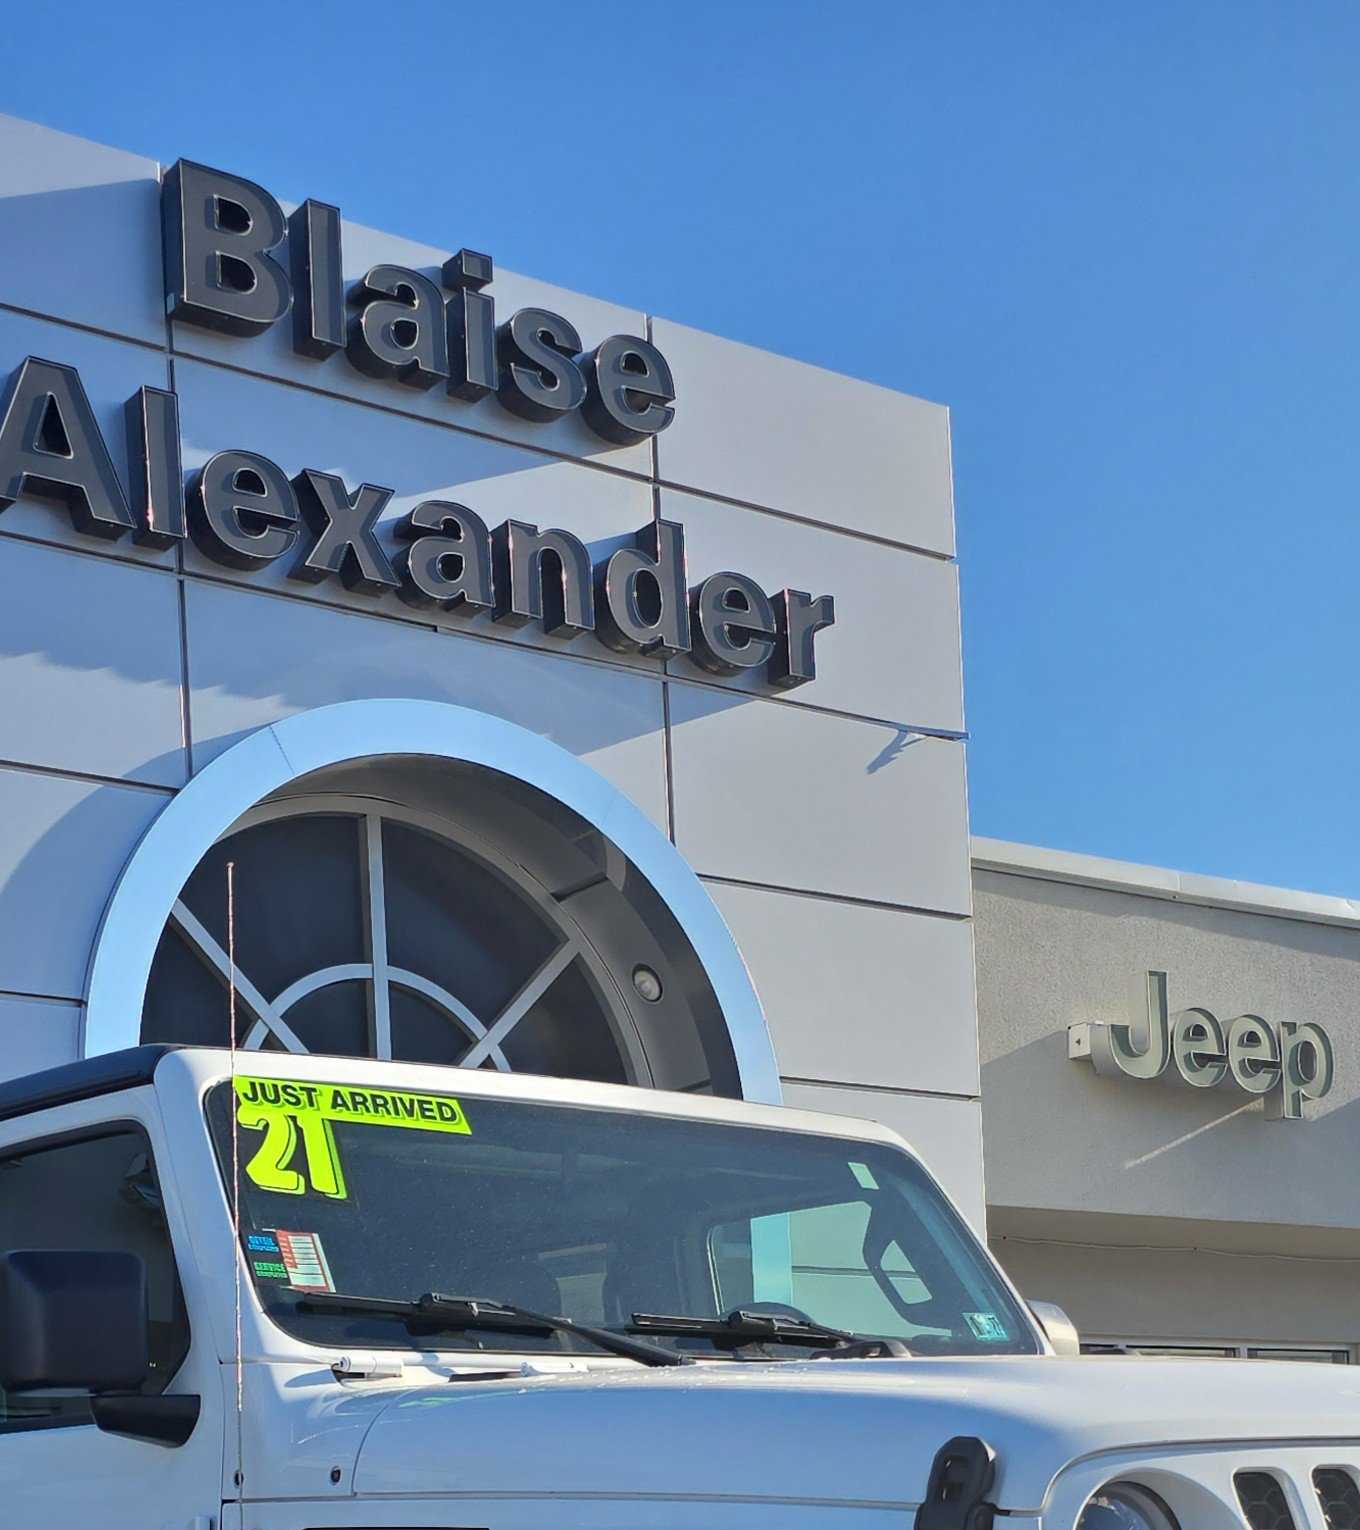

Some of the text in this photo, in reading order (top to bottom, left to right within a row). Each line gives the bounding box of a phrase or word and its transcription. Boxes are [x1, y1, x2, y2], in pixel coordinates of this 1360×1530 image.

[162, 158, 675, 446] Blaise
[242, 1082, 459, 1123] JUST ARRIVED
[1100, 970, 1334, 1121] Jeep
[237, 1109, 346, 1199] 21
